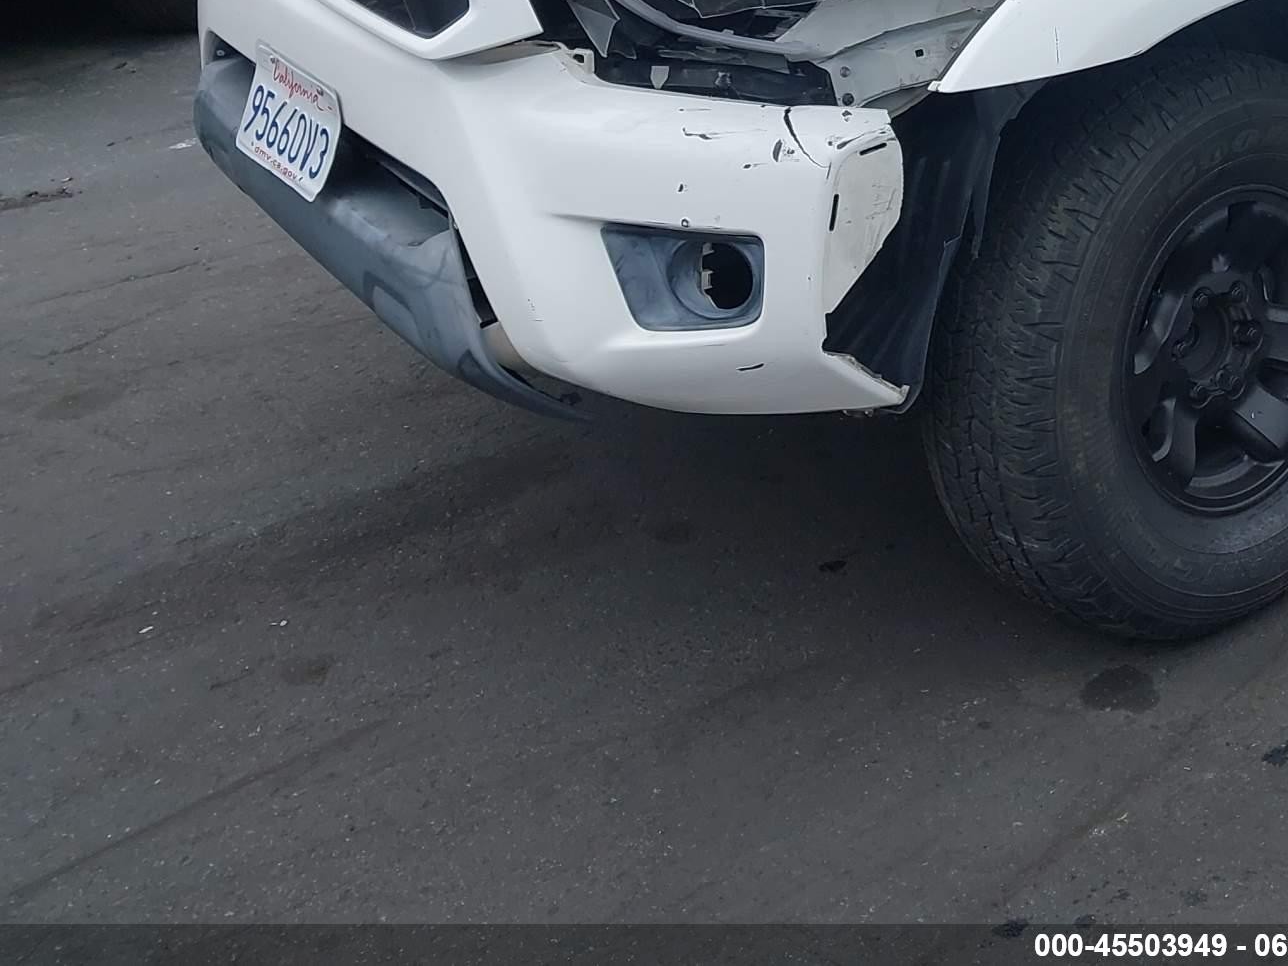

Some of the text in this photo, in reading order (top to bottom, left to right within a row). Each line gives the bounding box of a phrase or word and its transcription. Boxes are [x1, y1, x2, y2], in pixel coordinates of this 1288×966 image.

[272, 60, 324, 111] California
[244, 84, 330, 179] 95660V3
[254, 145, 298, 181] dmv.ca.gov
